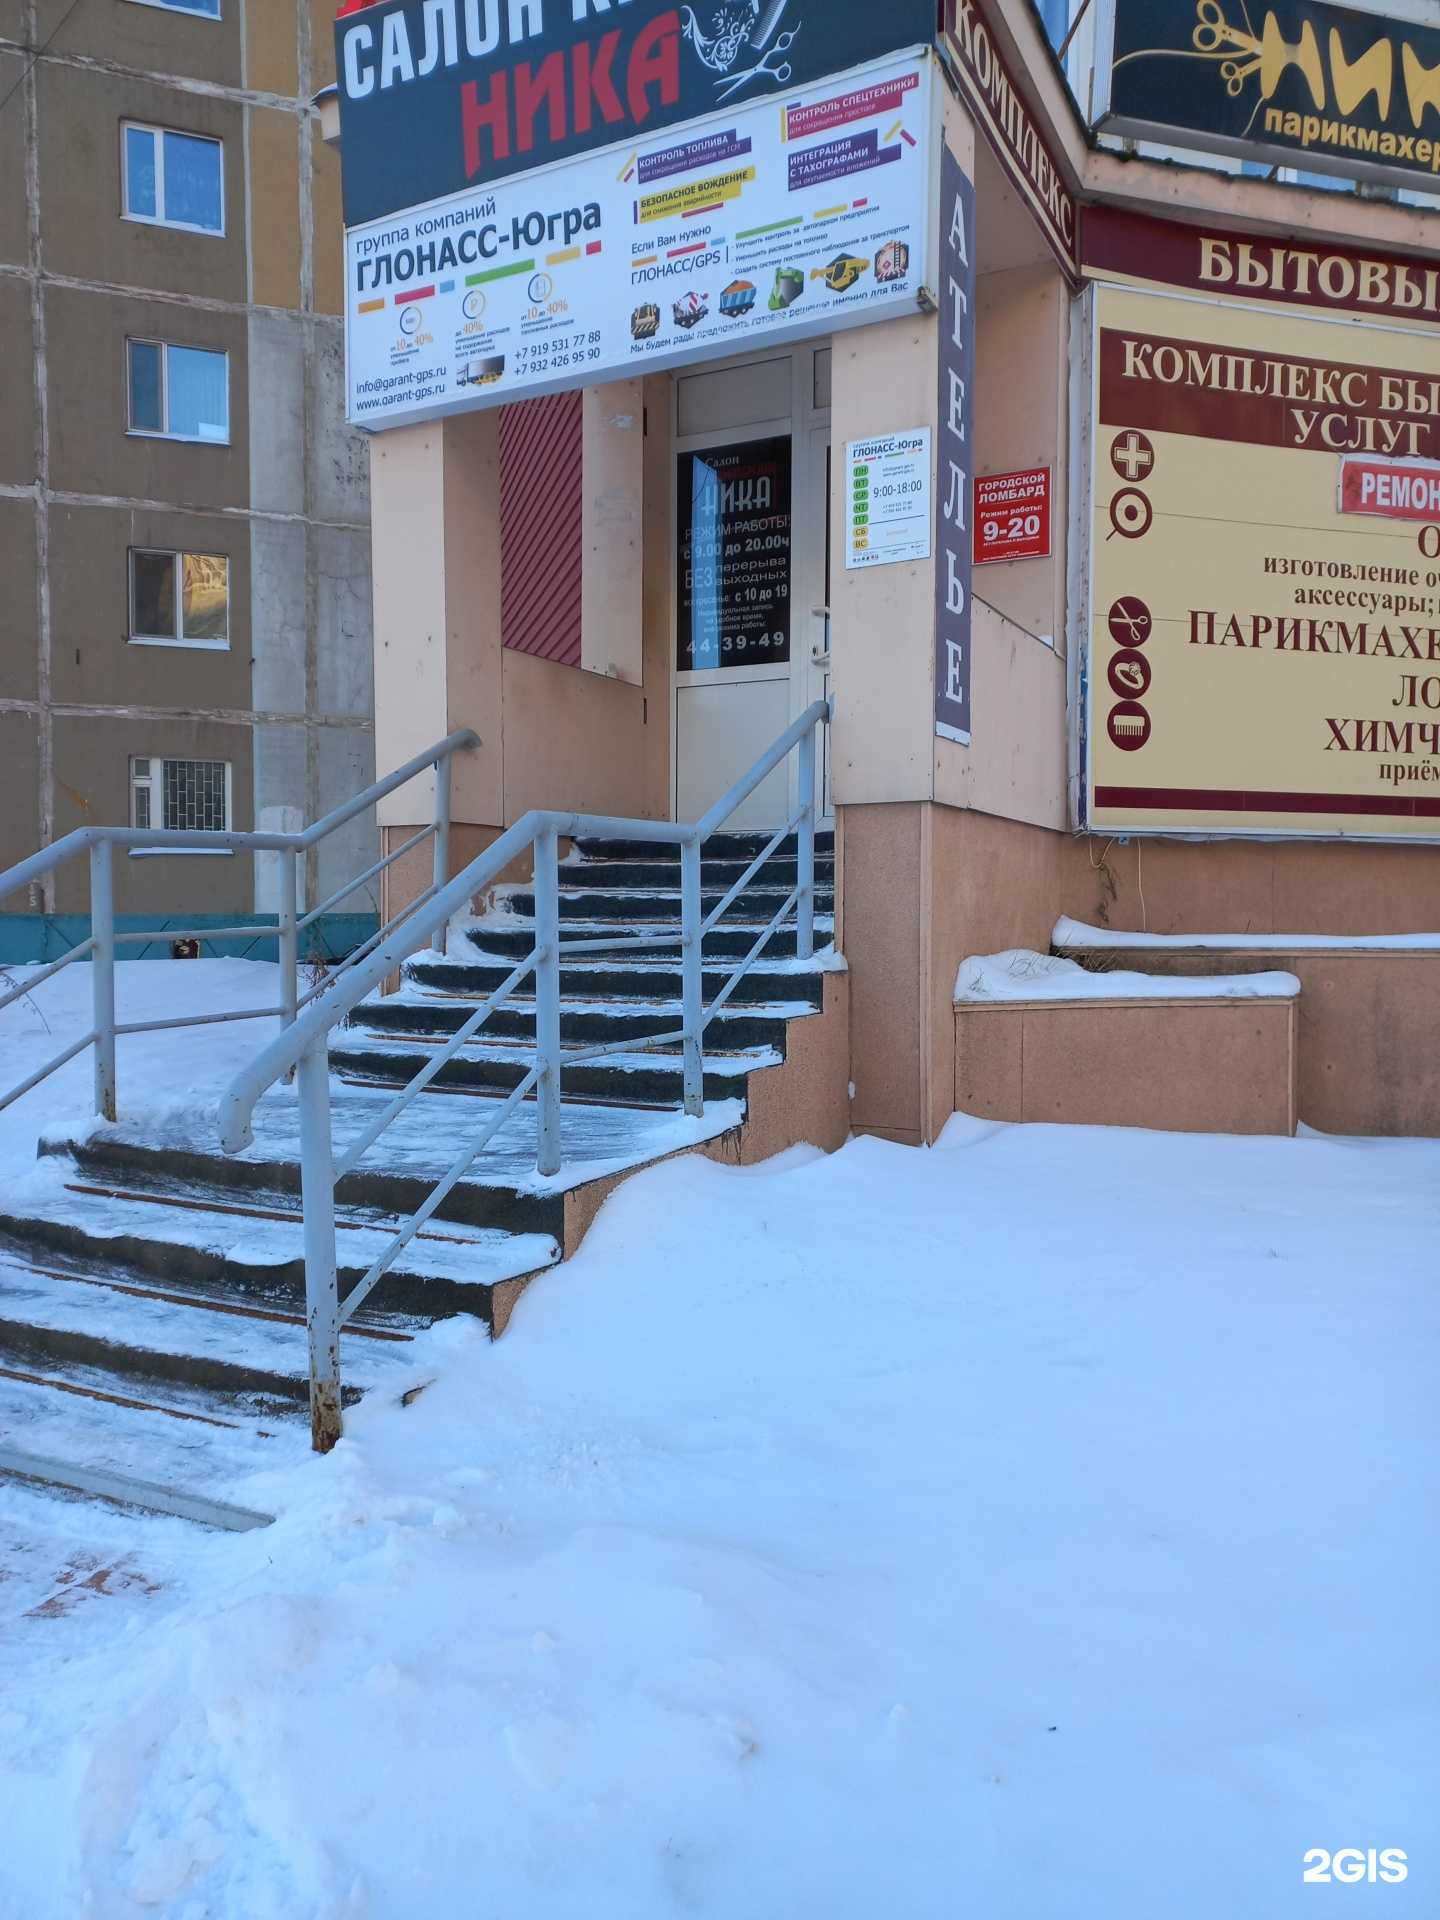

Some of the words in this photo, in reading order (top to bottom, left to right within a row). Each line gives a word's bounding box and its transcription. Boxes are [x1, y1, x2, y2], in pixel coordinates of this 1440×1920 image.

[343, 0, 544, 99] САЛОН
[461, 9, 681, 179] НИКА
[789, 101, 840, 124] КОНТРОЛЬ
[842, 77, 915, 107] СПЕЦТЕХНИКИ
[954, 0, 1072, 247] КОМПЛЕКС
[639, 149, 684, 168] КОНТРОЛЬ
[686, 135, 728, 154] ТОПЛИВА
[789, 140, 851, 166] ИНТЕГРАЦИЯ
[799, 147, 868, 174] ТАХОГРАФАМИ
[640, 185, 696, 208] БЕЗОПАСНОЕ
[698, 170, 748, 191] ВОЖДЕНИЕ
[356, 227, 410, 256] группа
[415, 196, 497, 236] компаний
[631, 240, 655, 254] Если
[657, 234, 677, 248] Вам
[679, 225, 711, 242] нужно
[357, 202, 602, 292] ГЛОНАСС-Югра
[631, 251, 721, 286] ГЛОНАСС/GPS
[630, 344, 644, 354] Мы
[646, 338, 671, 352] будем
[673, 333, 695, 346] рады
[870, 286, 888, 299] для
[891, 281, 909, 294] Вас
[514, 347, 528, 360] +7
[530, 342, 549, 358] 919
[551, 337, 569, 353] 531
[573, 334, 586, 347] 77
[588, 330, 601, 343] 88
[514, 364, 528, 377] +7
[530, 359, 549, 374] 932
[551, 354, 569, 368] 426
[570, 350, 585, 363] 95
[587, 347, 601, 360] 90
[1121, 340, 1368, 407] КОМПЛЕКС
[1290, 408, 1431, 456] УСЛУГ
[853, 439, 923, 458] ГЛОНАСС-Югра
[943, 192, 969, 705] АТЕЛЬЕ
[701, 476, 771, 516] НИКА
[873, 480, 922, 498] 9:00-18:00
[978, 473, 1046, 492] ГОРОДСКОЙ
[978, 485, 1045, 504] ЛОМБАРД
[980, 511, 1009, 519] Режим
[1010, 504, 1042, 516] работы:
[685, 523, 731, 541] РЕЖИМ
[983, 515, 1041, 542] 9-20
[695, 543, 721, 559] 9.00
[725, 543, 741, 557] до
[745, 535, 790, 552] 20.00ч
[685, 566, 714, 589] БЕЗ
[1264, 557, 1419, 586] изготовление
[735, 592, 742, 602] с
[745, 587, 757, 601] 10
[760, 588, 772, 602] до
[775, 584, 788, 598] 19
[1294, 587, 1434, 618] аксессуары;
